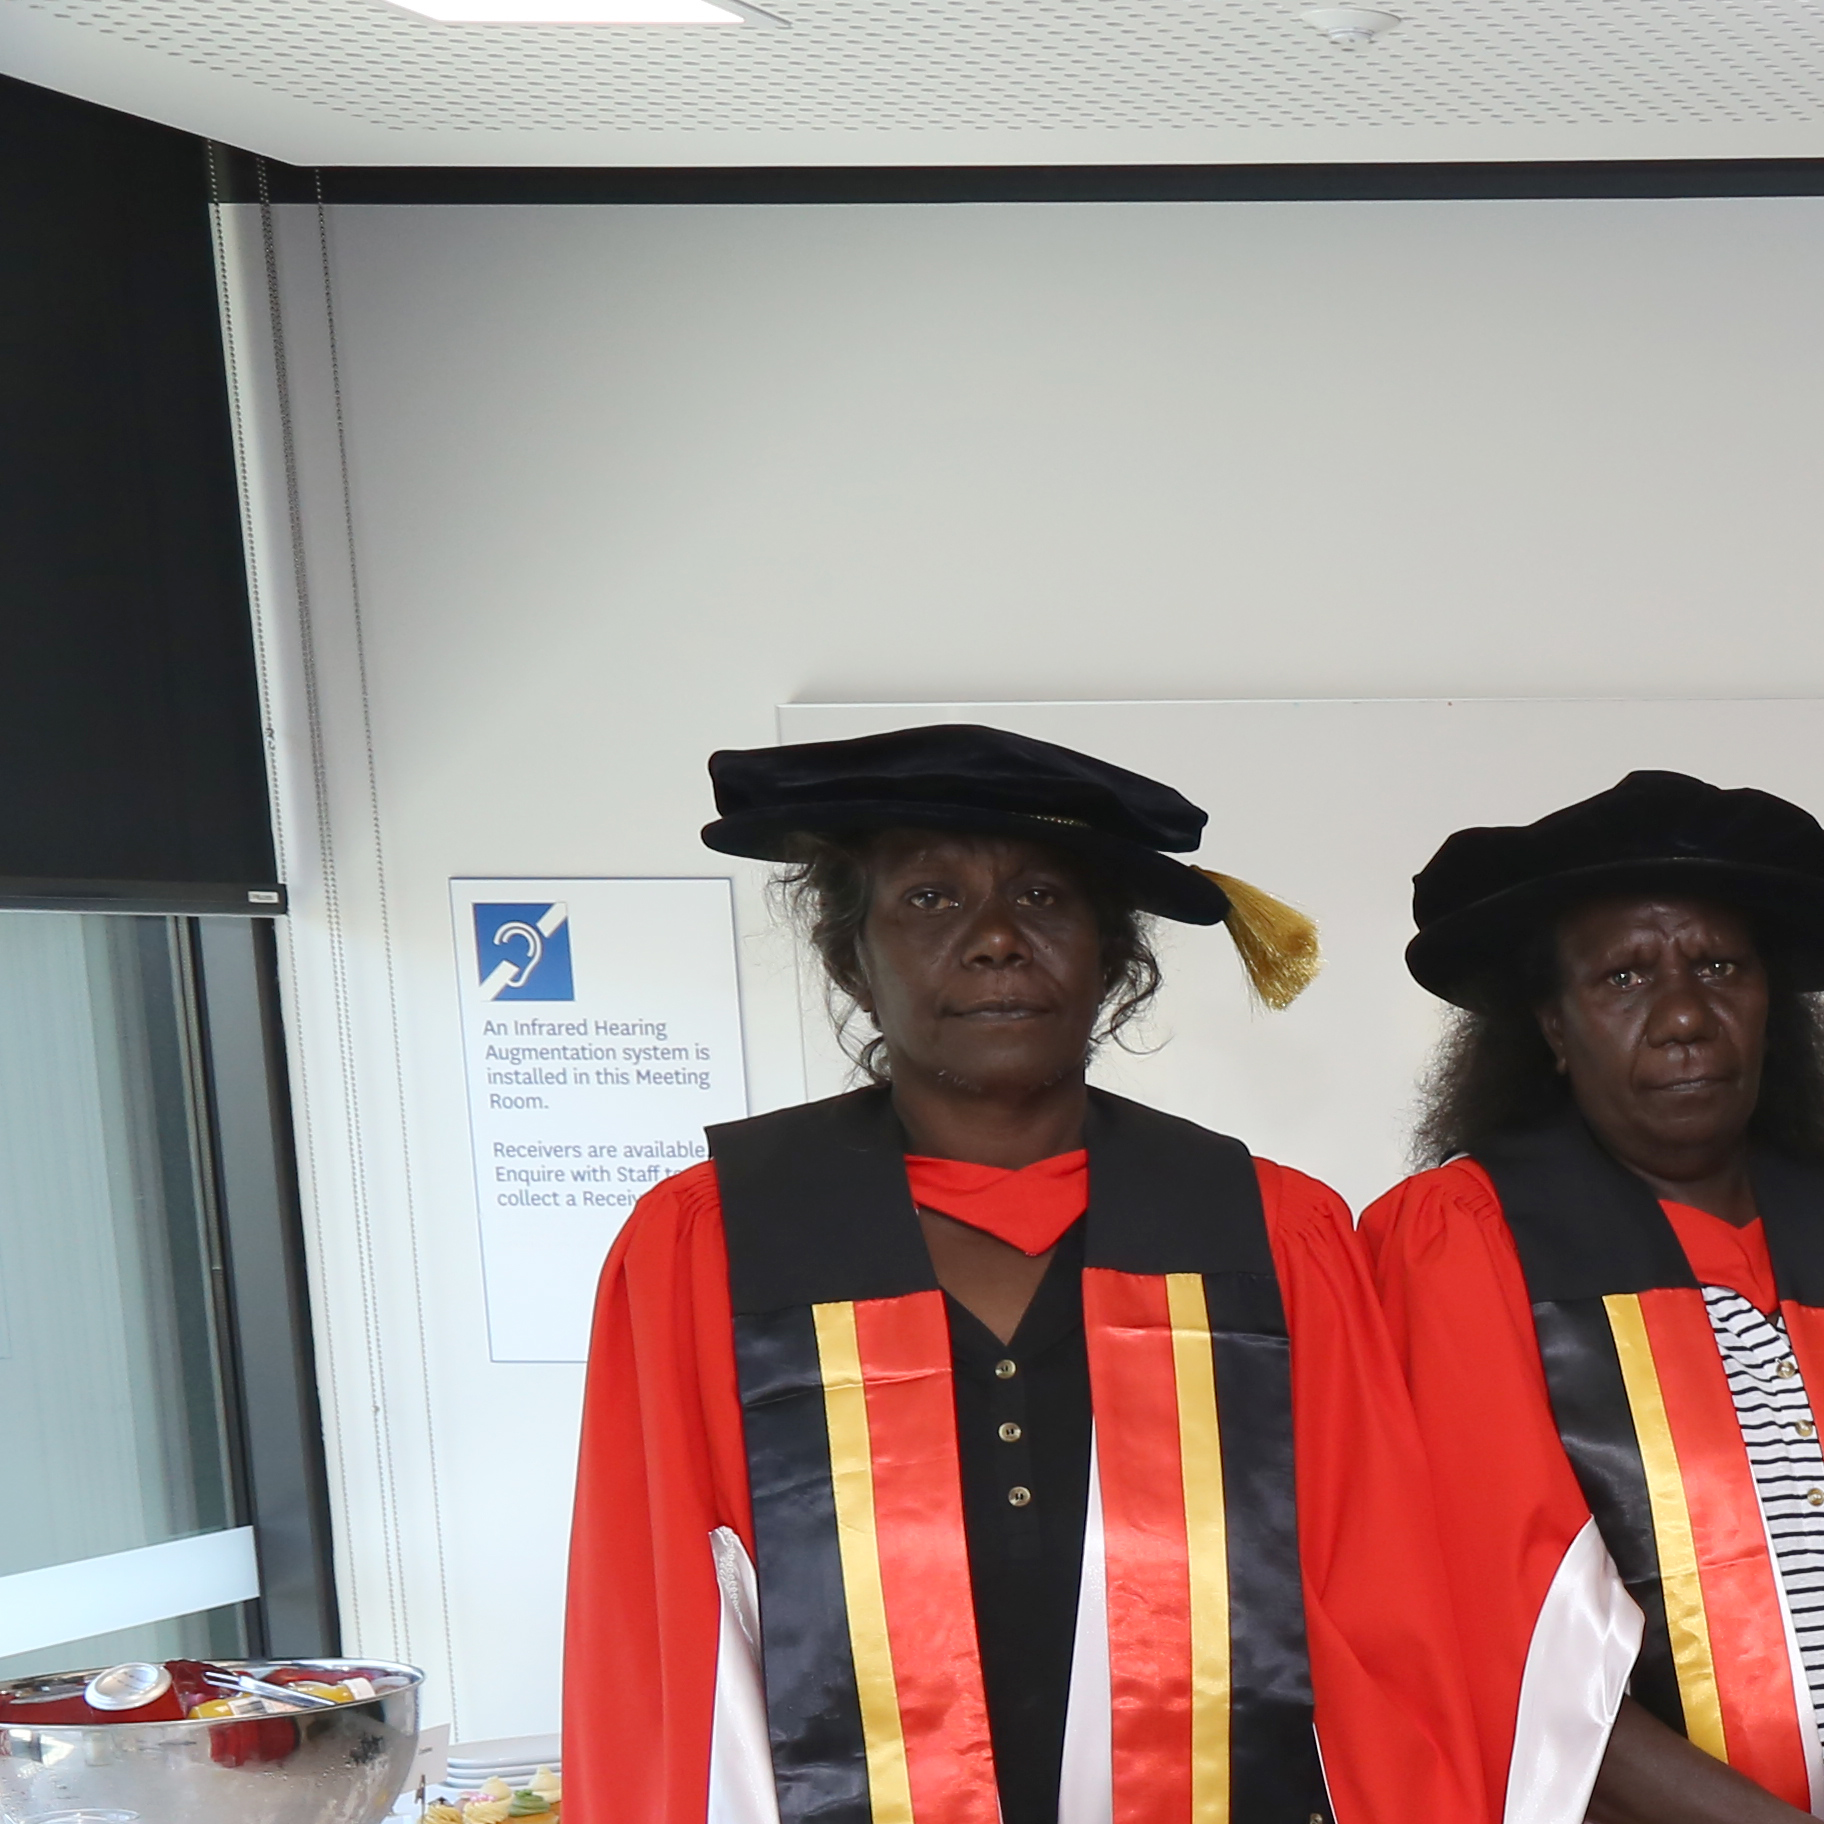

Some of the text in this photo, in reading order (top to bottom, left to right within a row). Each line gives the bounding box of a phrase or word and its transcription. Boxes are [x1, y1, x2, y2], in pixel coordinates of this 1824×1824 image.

[483, 1018, 667, 1041] An Infrared Hearing
[485, 1043, 710, 1065] Augmentation system is
[487, 1067, 711, 1090] installed in this Meeting
[490, 1093, 549, 1110] Room.
[493, 1141, 583, 1158] Receivers
[587, 1146, 617, 1158] are
[495, 1166, 565, 1186] Enquire
[571, 1166, 611, 1182] with
[616, 1164, 661, 1182] Staff
[497, 1188, 560, 1207] collect
[566, 1194, 577, 1207] a
